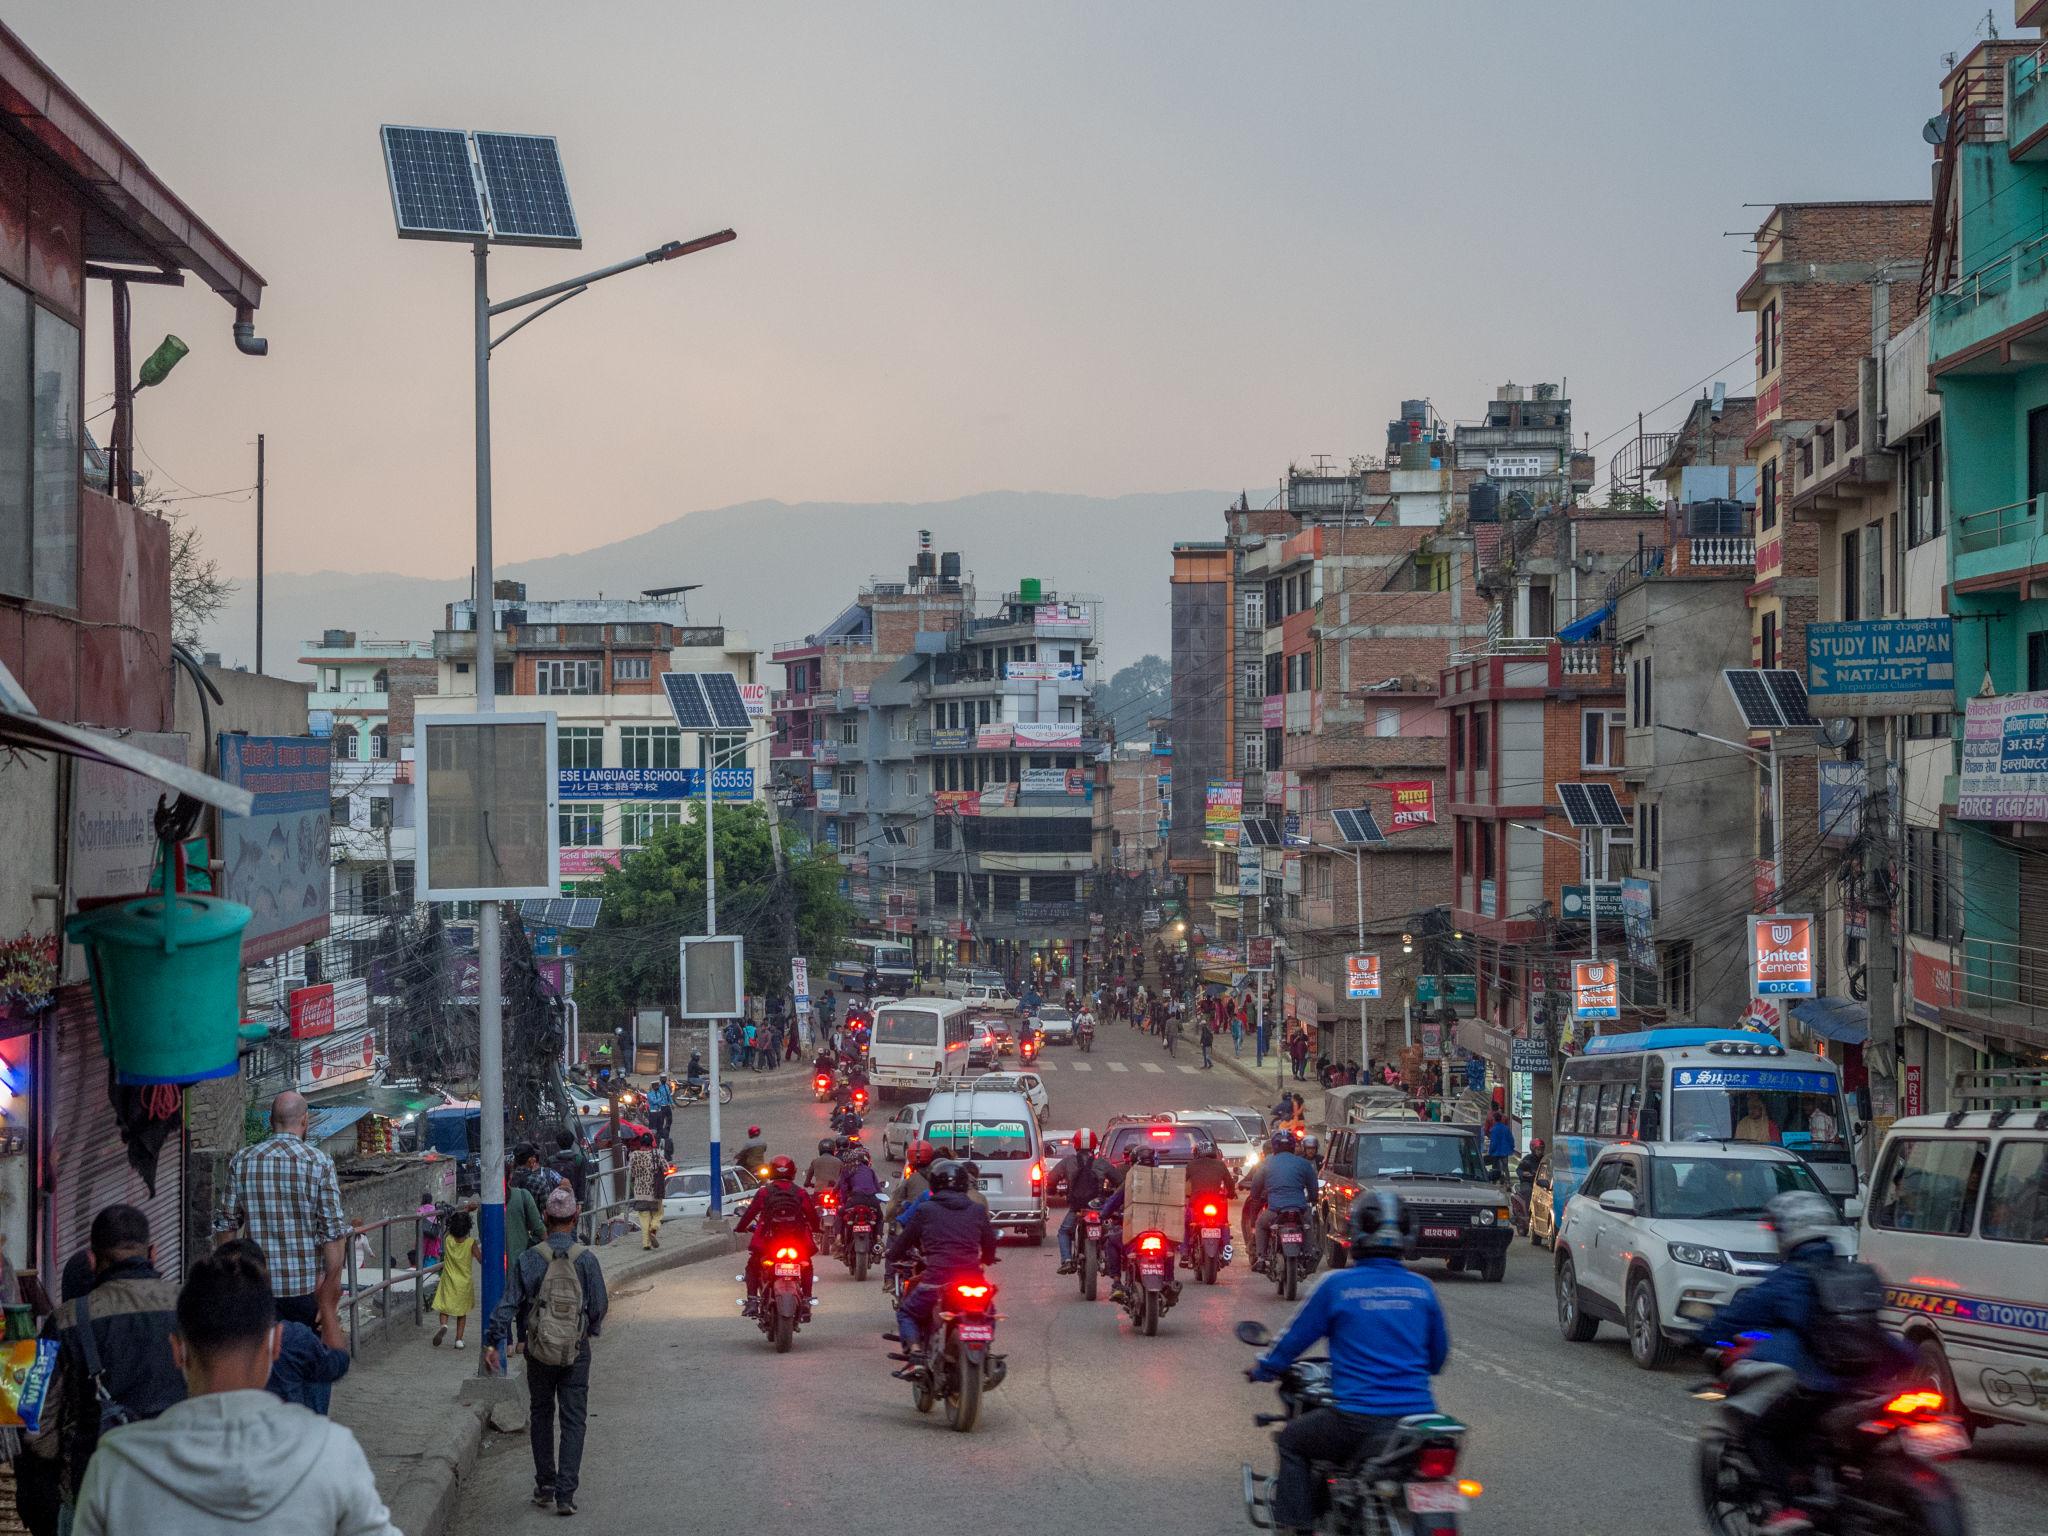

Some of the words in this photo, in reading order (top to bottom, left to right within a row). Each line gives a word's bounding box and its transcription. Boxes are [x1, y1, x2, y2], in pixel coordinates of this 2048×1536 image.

[1810, 636, 1867, 657] STUDY
[1872, 635, 1890, 655] IN
[1895, 633, 1950, 654] JAPAN
[1836, 667, 1926, 682] NAT/JLPT
[1839, 683, 1889, 692] Preparation
[559, 770, 580, 782] ESE
[582, 770, 640, 783] LANGUAGE
[643, 770, 687, 782] SCHOOL
[1960, 797, 1993, 817] FORCE
[1758, 947, 1808, 962] United
[1758, 961, 1808, 973] Cements
[1350, 970, 1378, 979] United
[1769, 982, 1799, 993] O.P.C.
[1695, 1069, 1751, 1085] Super
[932, 1124, 982, 1133] TOURIST
[999, 1124, 1022, 1133] ONLY
[1885, 1290, 1958, 1315] PORTS
